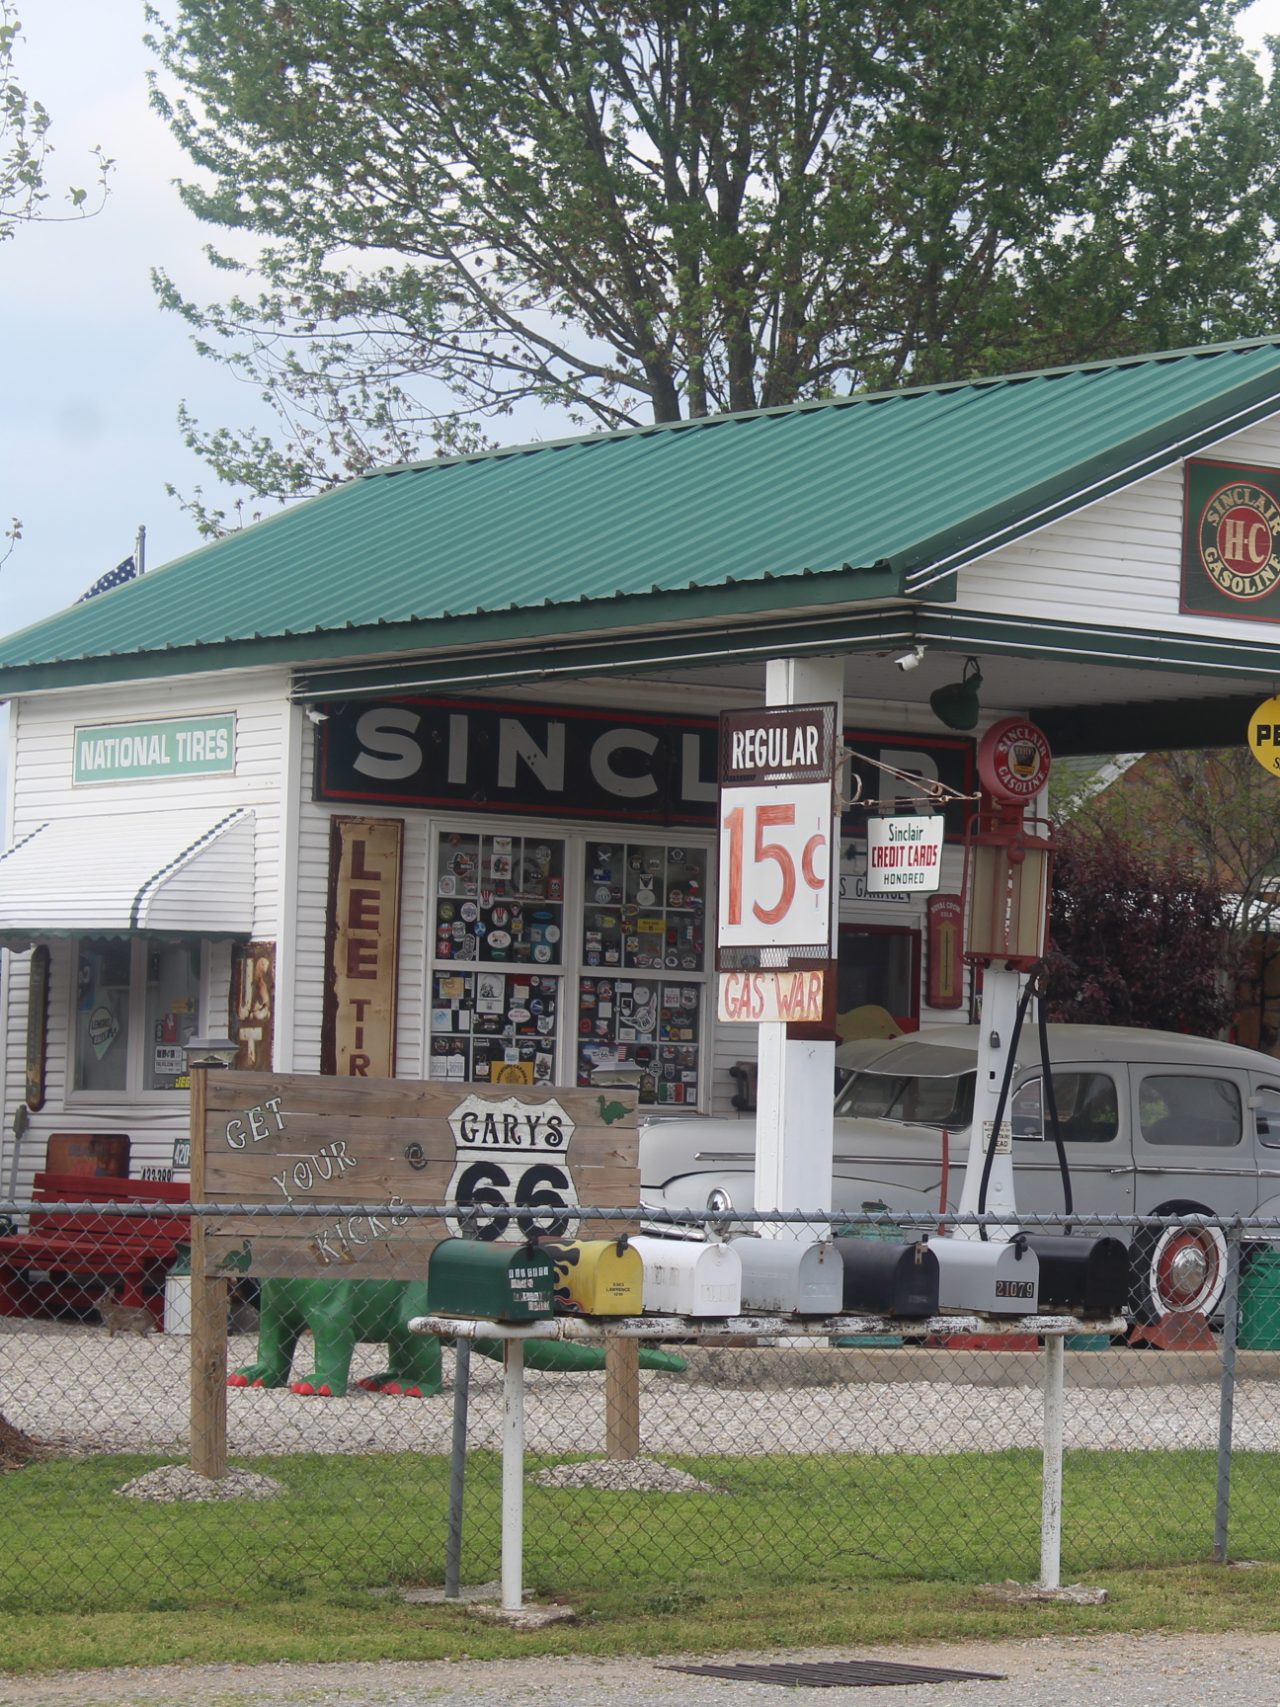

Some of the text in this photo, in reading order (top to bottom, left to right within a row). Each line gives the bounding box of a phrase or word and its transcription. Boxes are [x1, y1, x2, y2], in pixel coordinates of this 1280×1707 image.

[81, 729, 228, 770] NATIONAL TIRES
[353, 707, 939, 815] SINCLR
[732, 725, 818, 769] REGULAR
[999, 729, 1046, 756] SINCLAIR
[998, 766, 1046, 792] GASOLINE
[889, 823, 924, 842] Sinclair
[872, 845, 938, 868] CREDIT CARDS
[884, 873, 925, 885] HONORED
[346, 840, 381, 980] LEE
[725, 971, 765, 1019] GAS
[774, 971, 822, 1019] WAR
[225, 1097, 286, 1150] GET
[460, 1111, 564, 1147] GARY'S
[273, 1140, 357, 1203] YOUR
[457, 1161, 570, 1241] 66
[996, 1281, 1033, 1297] 21079
